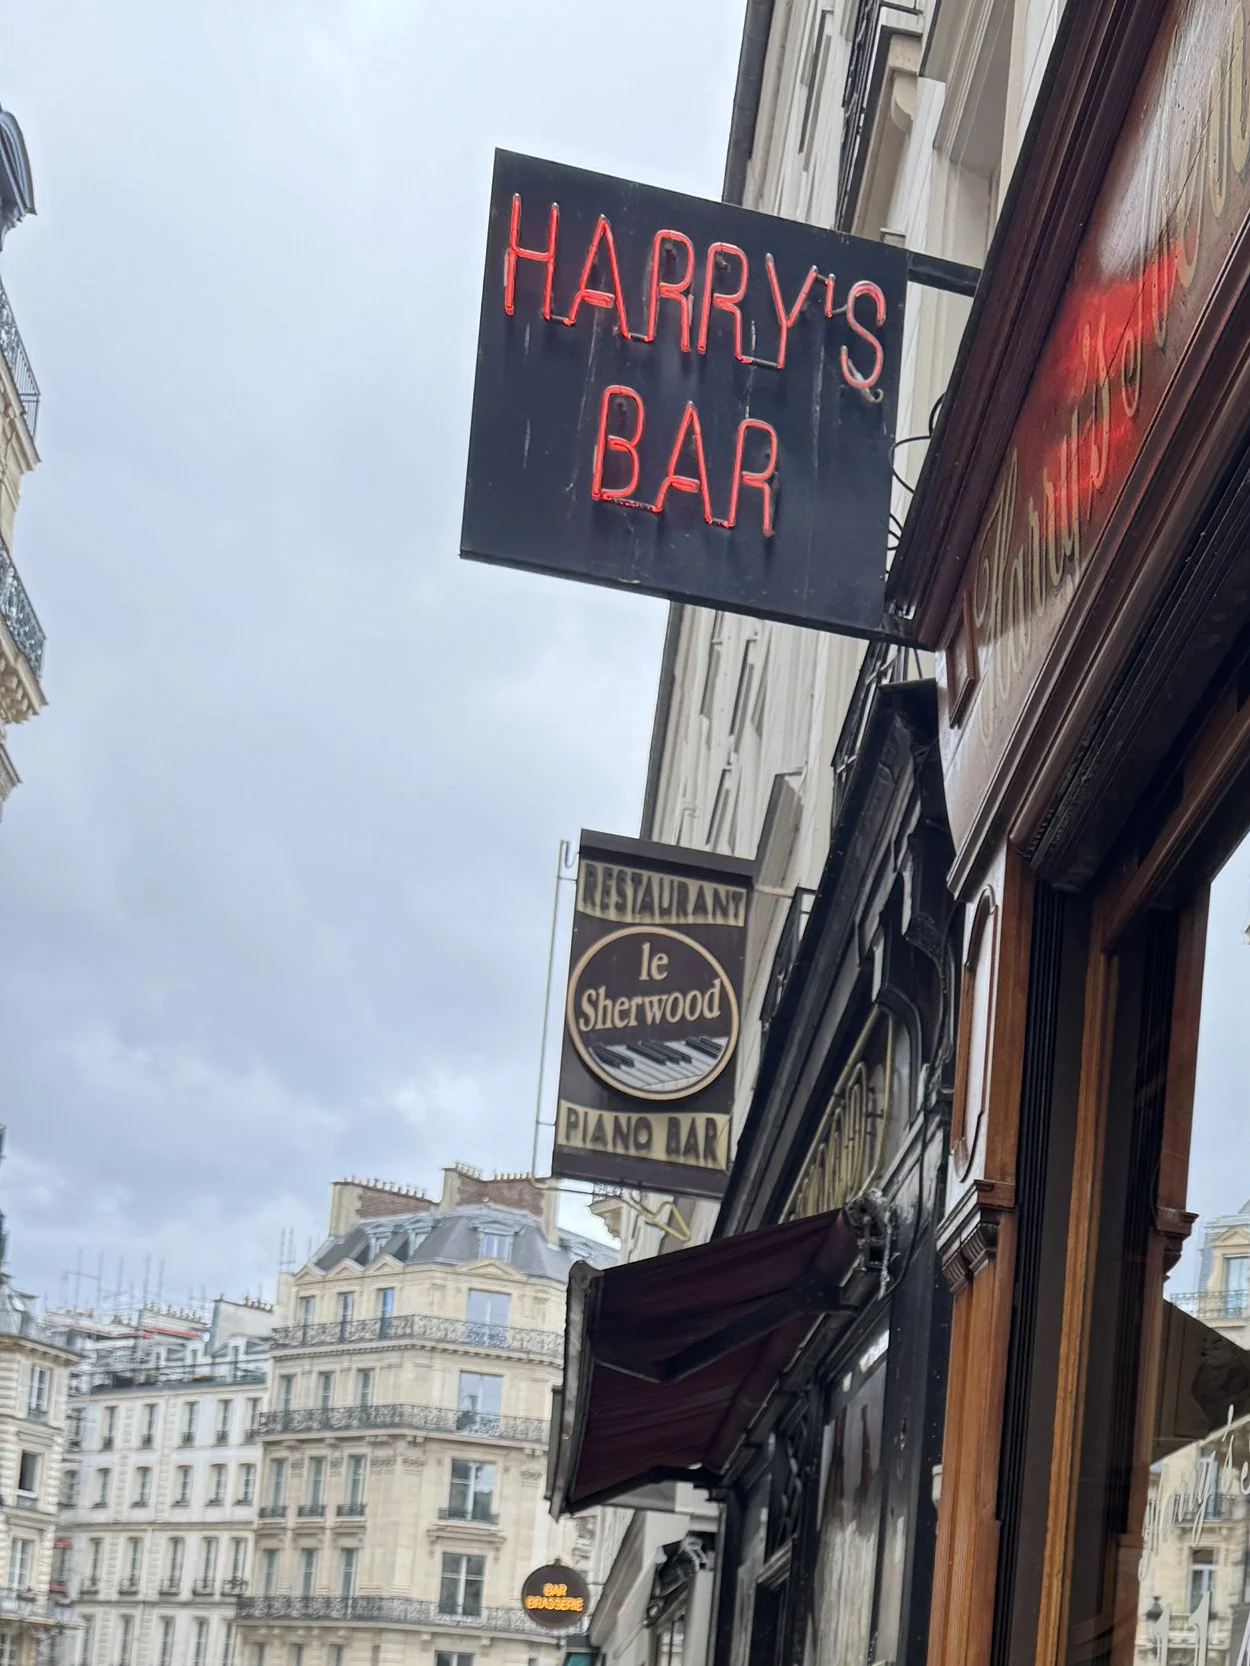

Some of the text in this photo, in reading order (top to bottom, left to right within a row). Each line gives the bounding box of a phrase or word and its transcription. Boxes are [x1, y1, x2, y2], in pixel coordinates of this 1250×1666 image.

[504, 192, 887, 390] HARRY'S
[592, 384, 777, 537] BAR
[973, 310, 1112, 750] Harry's
[583, 862, 746, 921] RESTAURANT
[639, 941, 669, 981] le
[579, 978, 721, 1033] Sherwood
[564, 1108, 719, 1162] PIANO BAR
[526, 1595, 585, 1612] BRASSERIE
[543, 1582, 568, 1597] BAR
